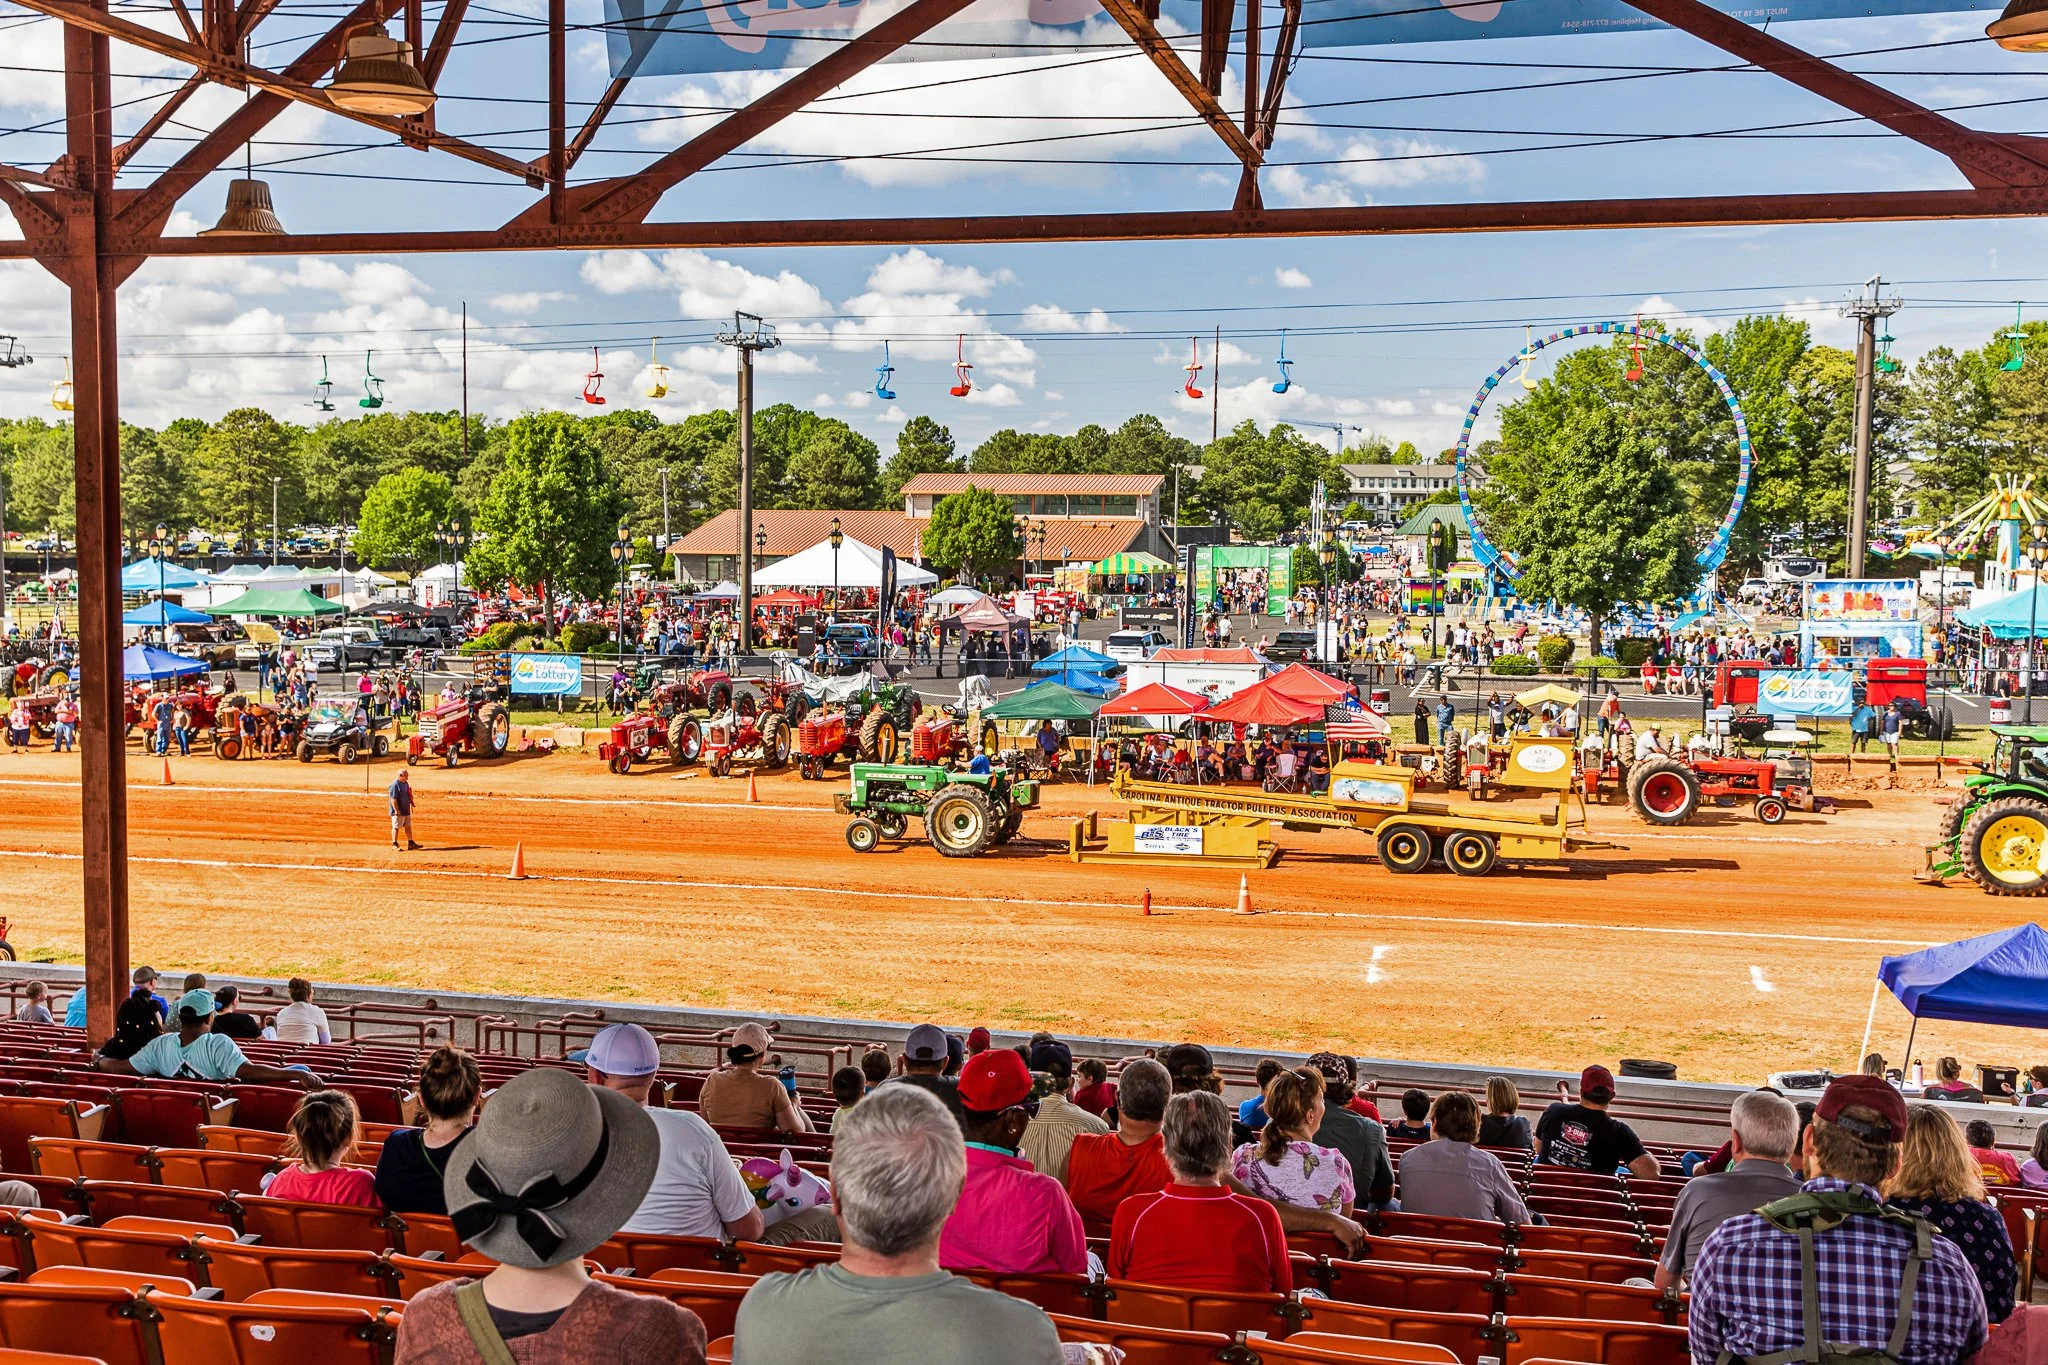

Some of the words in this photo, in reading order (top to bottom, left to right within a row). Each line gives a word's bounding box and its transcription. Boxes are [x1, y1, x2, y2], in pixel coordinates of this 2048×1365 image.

[535, 669, 574, 682] Lottery
[1791, 687, 1844, 703] Lottery
[1120, 790, 1161, 802] CAROLINA
[1164, 796, 1201, 807] ANTIQUE
[1205, 799, 1243, 811] TRACTOR
[1246, 803, 1287, 815] PULLERS
[1290, 810, 1357, 822] ASSOCIATION
